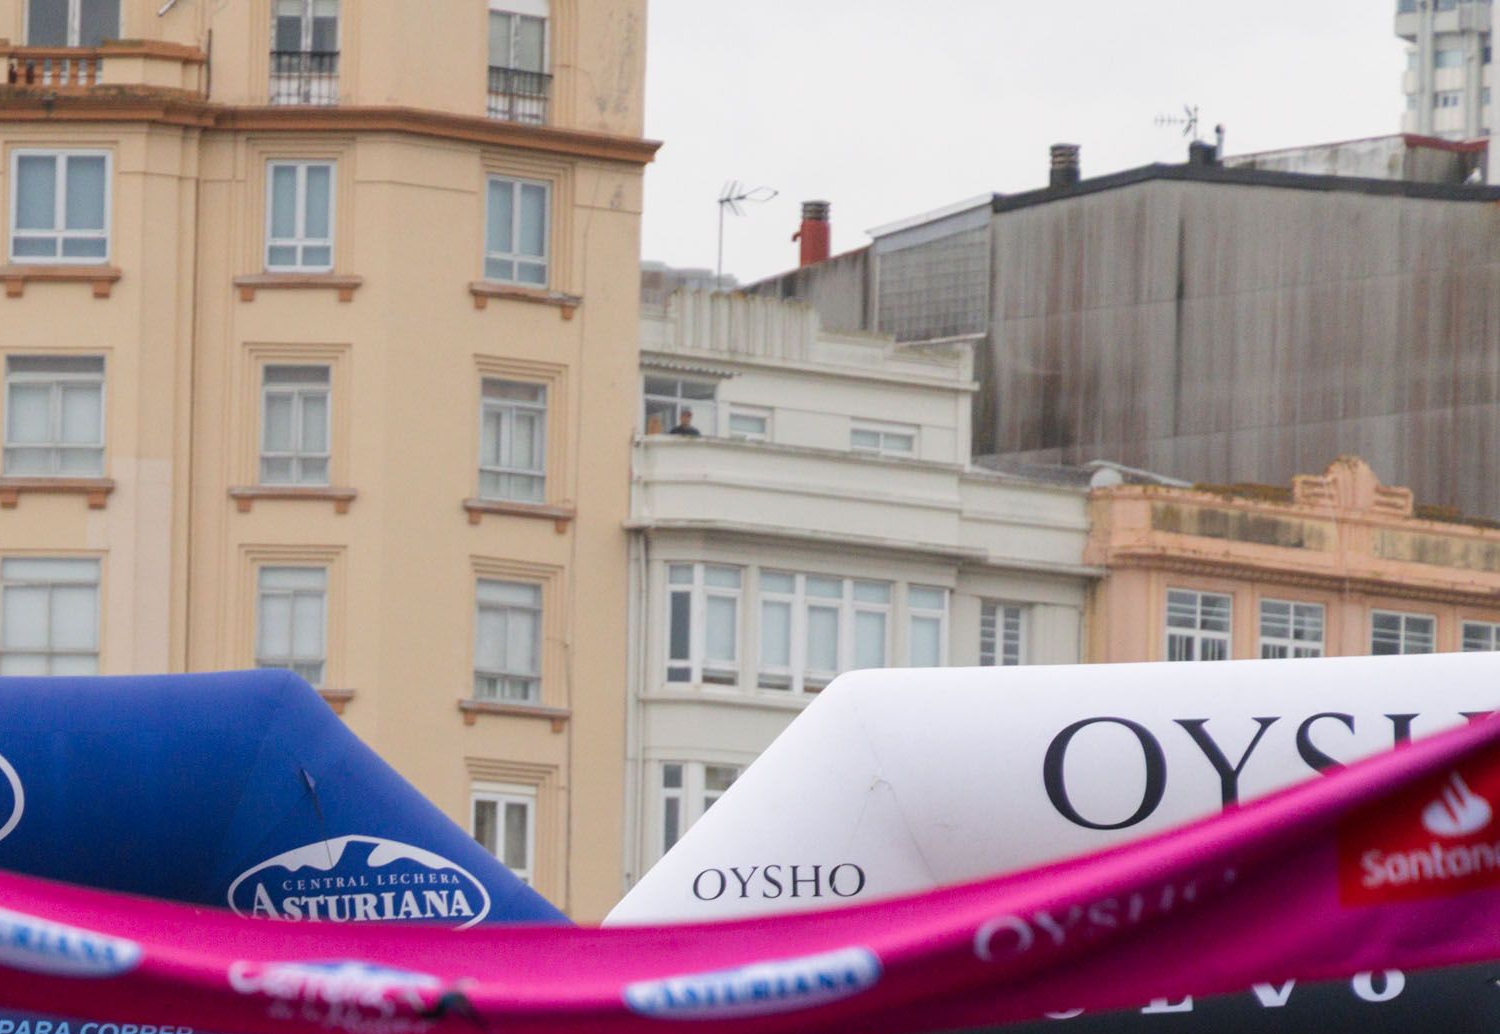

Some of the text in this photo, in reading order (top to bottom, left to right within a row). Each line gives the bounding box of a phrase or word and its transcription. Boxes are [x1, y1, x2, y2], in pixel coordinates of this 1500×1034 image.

[1043, 711, 1500, 830] OYS
[283, 873, 460, 891] CENTRAL LECHERA
[693, 863, 865, 901] OYSHO
[253, 882, 475, 923] ASTURIANA
